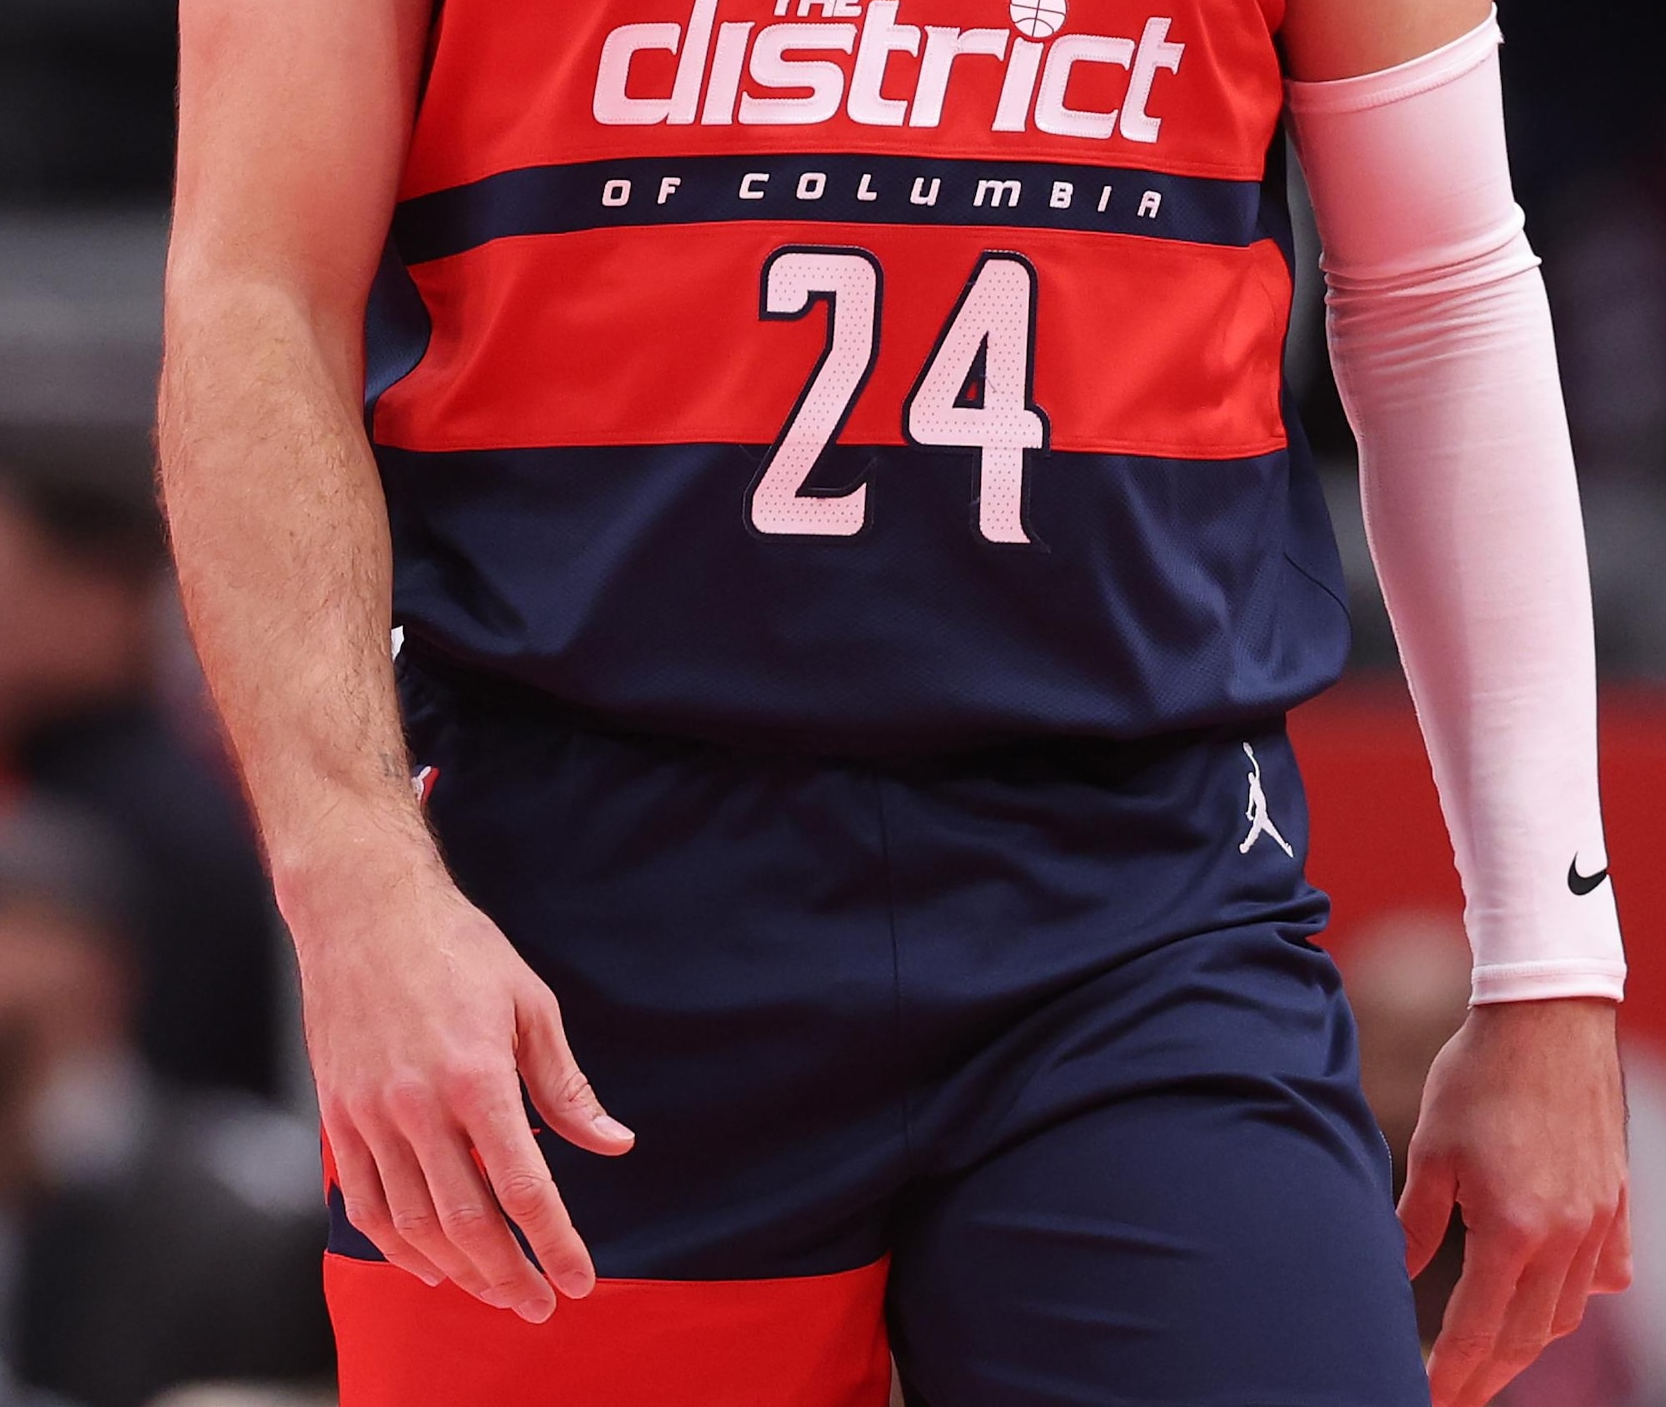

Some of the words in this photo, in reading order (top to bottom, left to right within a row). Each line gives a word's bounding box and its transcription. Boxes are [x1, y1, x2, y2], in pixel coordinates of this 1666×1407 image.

[601, 176, 682, 207] OF
[738, 171, 1163, 220] COLUMBIA
[746, 246, 1050, 545] 24
